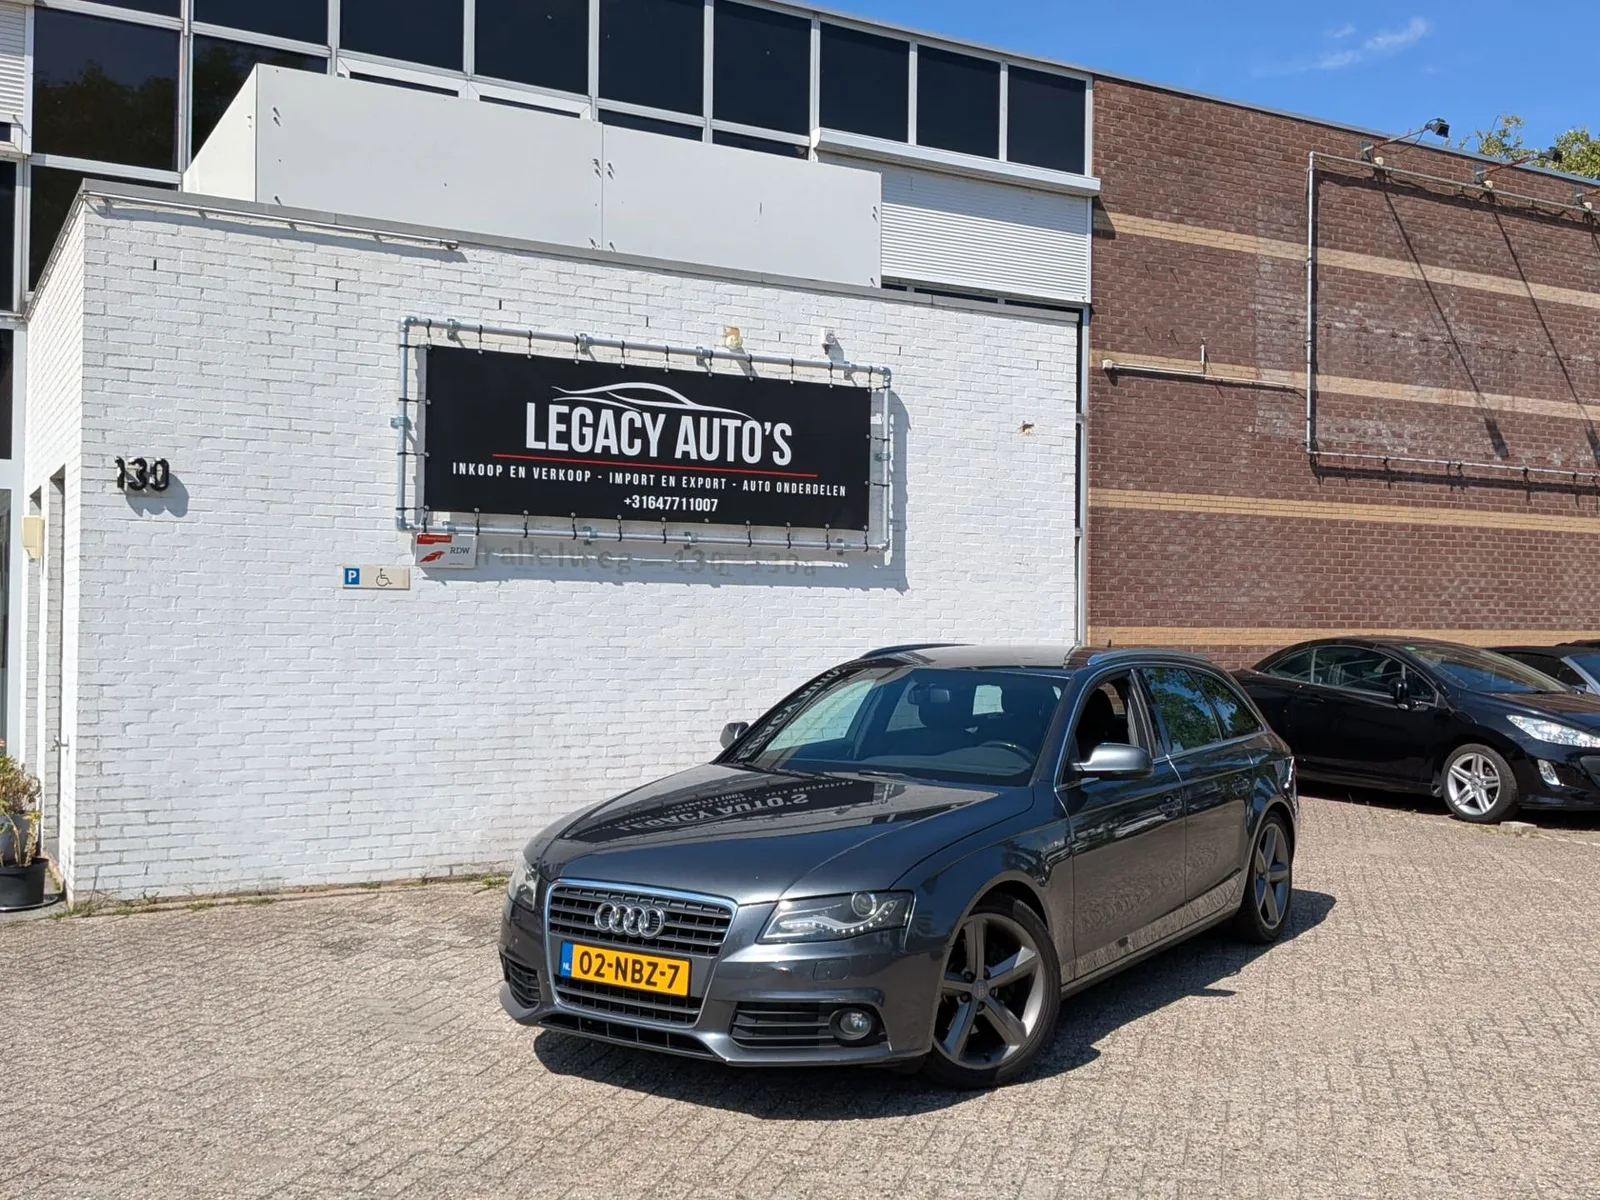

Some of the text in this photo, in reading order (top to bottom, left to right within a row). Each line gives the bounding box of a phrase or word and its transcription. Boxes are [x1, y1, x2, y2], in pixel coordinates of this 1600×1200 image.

[526, 402, 792, 466] LEGACY AUTO'S
[115, 456, 169, 492] 130
[453, 462, 503, 477] INKOOP
[510, 465, 526, 479] EN
[533, 467, 591, 483] VERKOOP
[609, 472, 656, 487] IMPORT
[661, 475, 676, 488] EN
[682, 476, 726, 490] EXPORT
[742, 480, 771, 493] AUTO
[776, 481, 847, 497] ONDERDELEN
[623, 494, 719, 512] +31647711007
[450, 546, 470, 554] RDW
[347, 570, 357, 583] P
[562, 950, 681, 989] NL 02-NBZ-7
